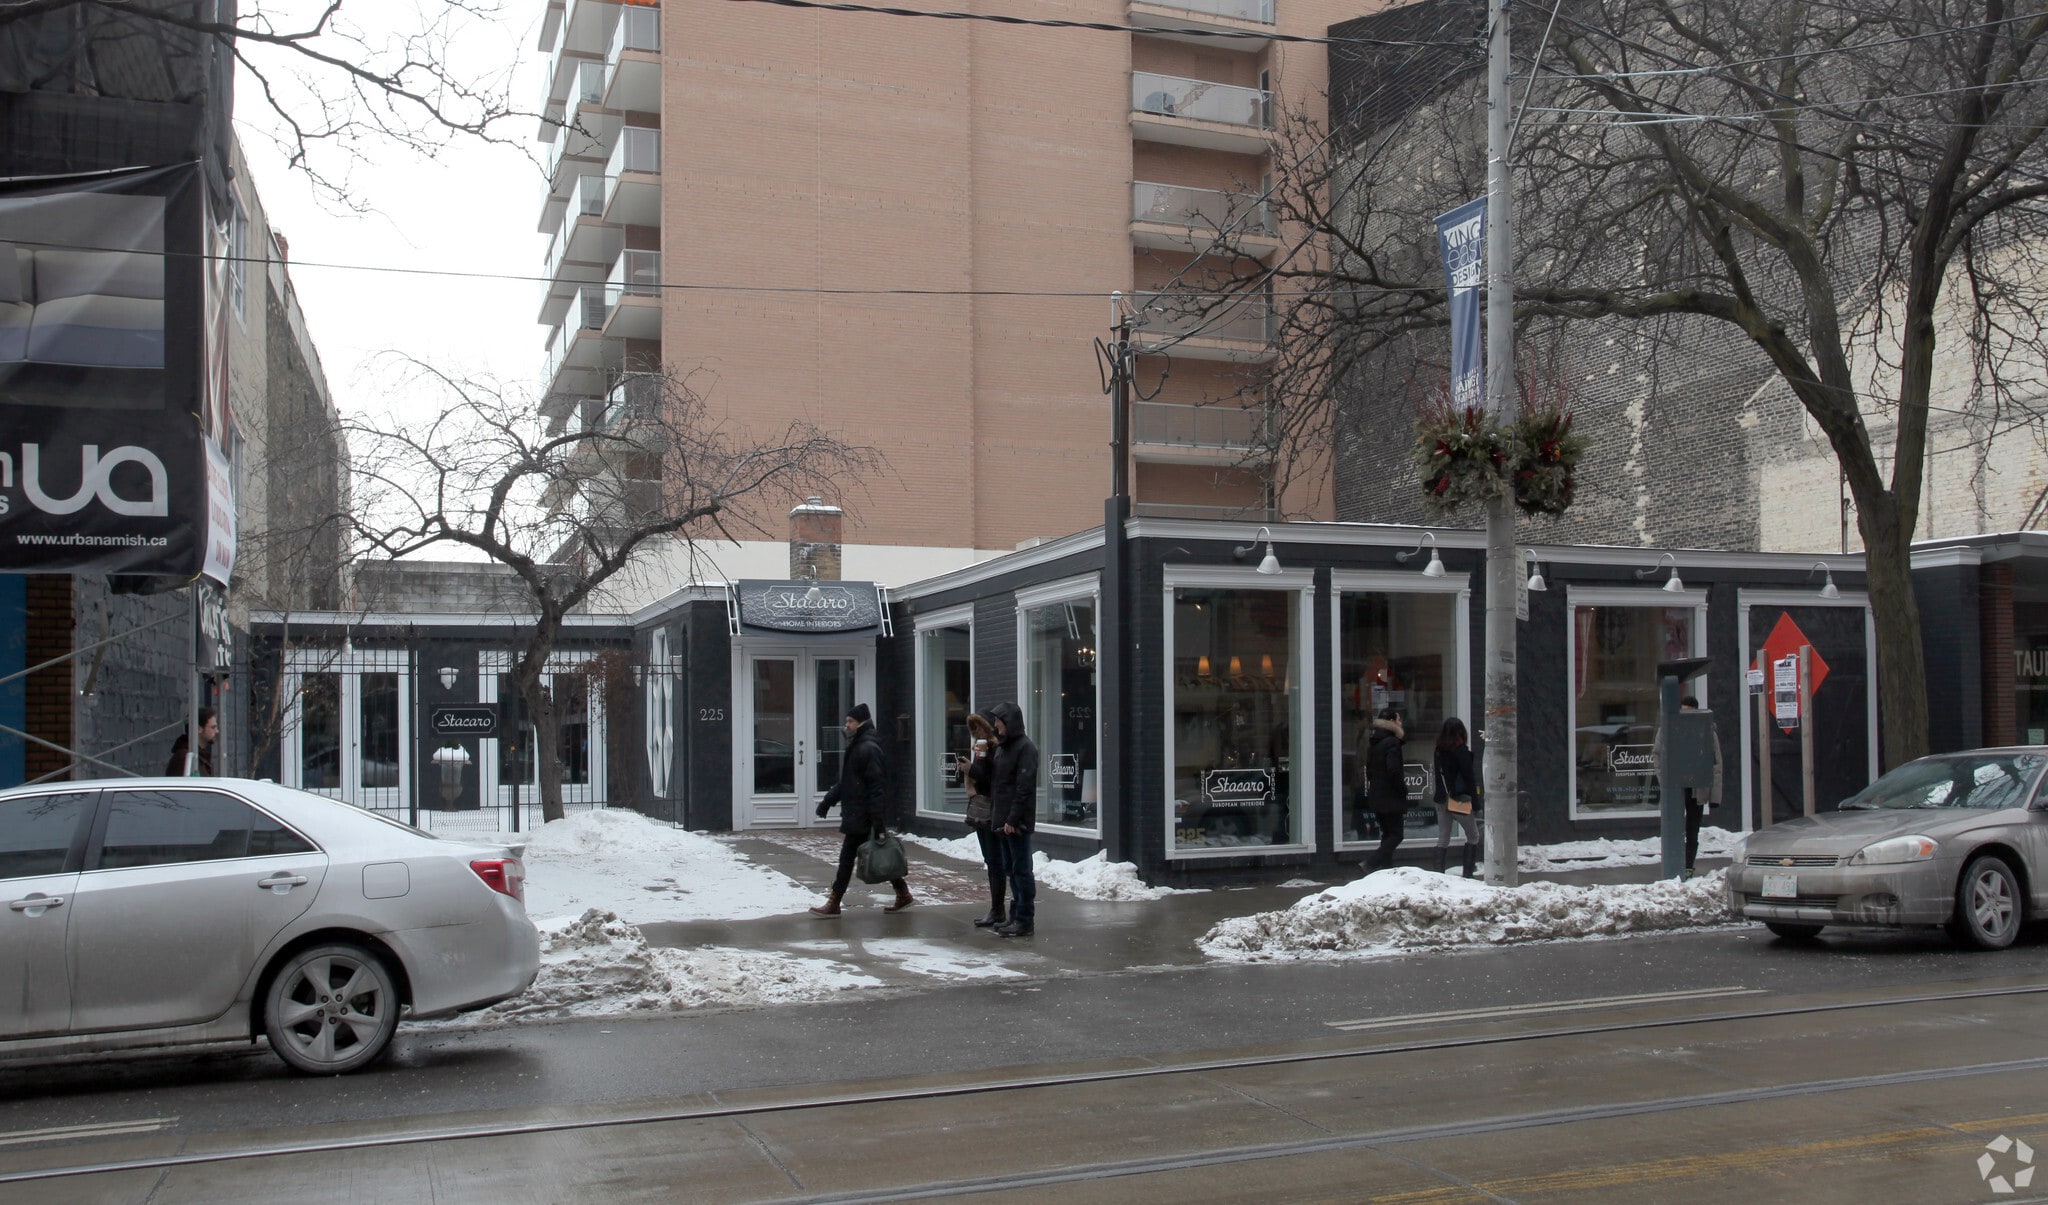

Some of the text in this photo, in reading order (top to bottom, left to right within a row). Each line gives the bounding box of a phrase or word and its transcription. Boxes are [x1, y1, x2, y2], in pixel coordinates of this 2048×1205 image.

[1446, 221, 1481, 250] KING
[1446, 237, 1485, 271] east
[17, 533, 168, 547] www.urbanamish.ca
[437, 713, 492, 728] Stacaro
[700, 708, 724, 721] 225
[1210, 776, 1265, 793] Stacaro
[1239, 800, 1265, 808] INTERIORS
